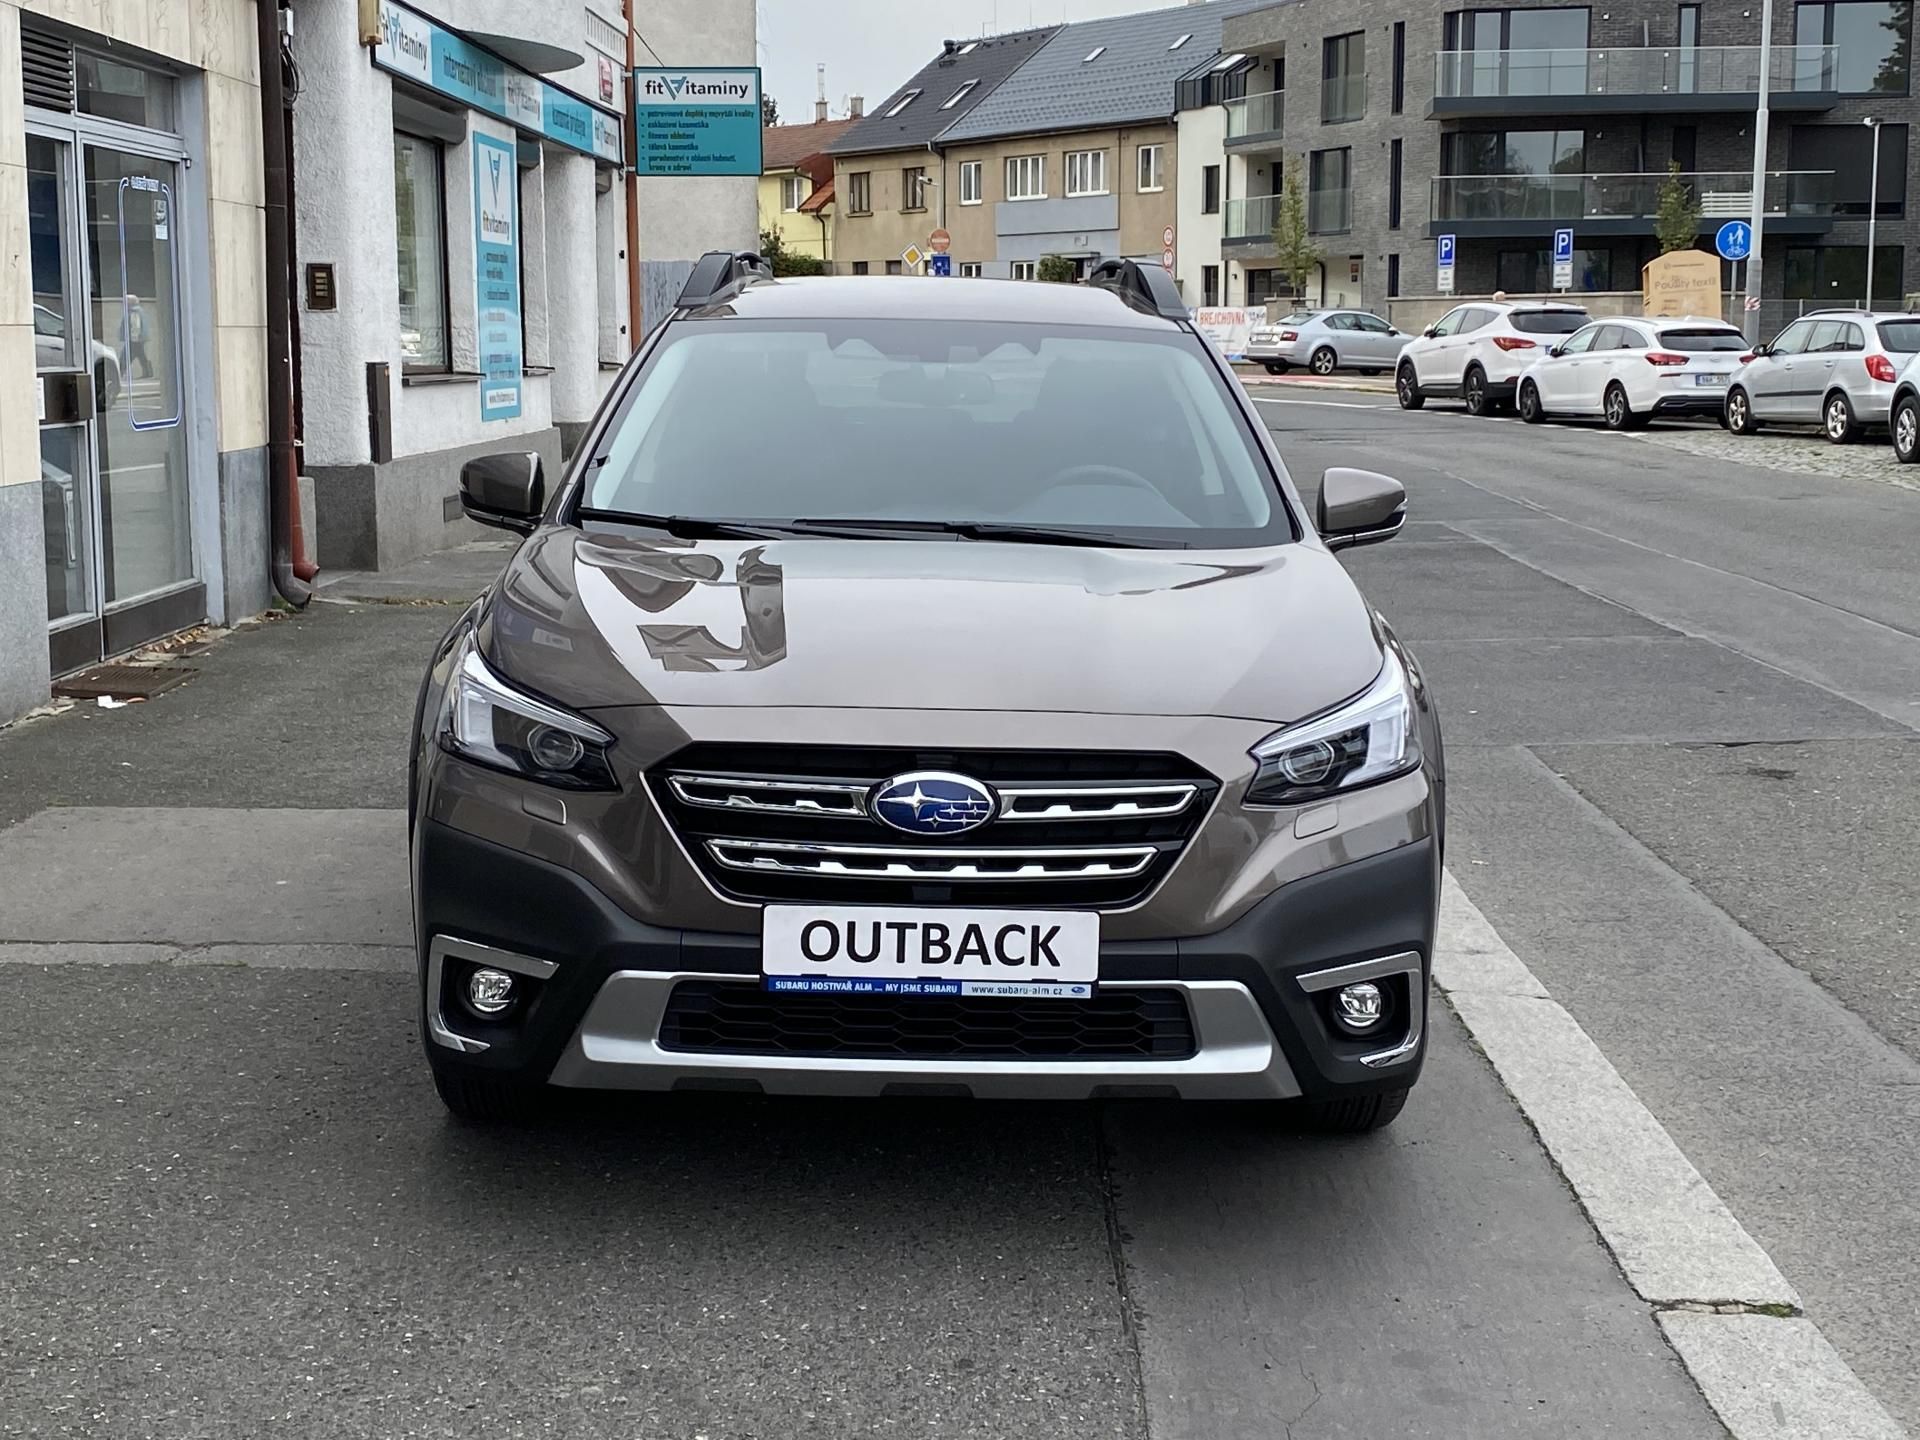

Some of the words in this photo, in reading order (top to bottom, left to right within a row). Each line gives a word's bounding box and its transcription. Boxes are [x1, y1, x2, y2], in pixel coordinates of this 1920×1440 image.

[645, 76, 748, 100] fitVitaminy
[1441, 239, 1452, 258] P
[1558, 234, 1569, 253] P
[801, 920, 1061, 967] OUTBACK
[775, 981, 809, 990] SUBARU
[811, 980, 853, 991] HOSTIVAŘ
[854, 983, 872, 991] ALM
[885, 984, 898, 992] MY
[900, 984, 921, 993] JSME
[924, 984, 957, 993] SUBARU
